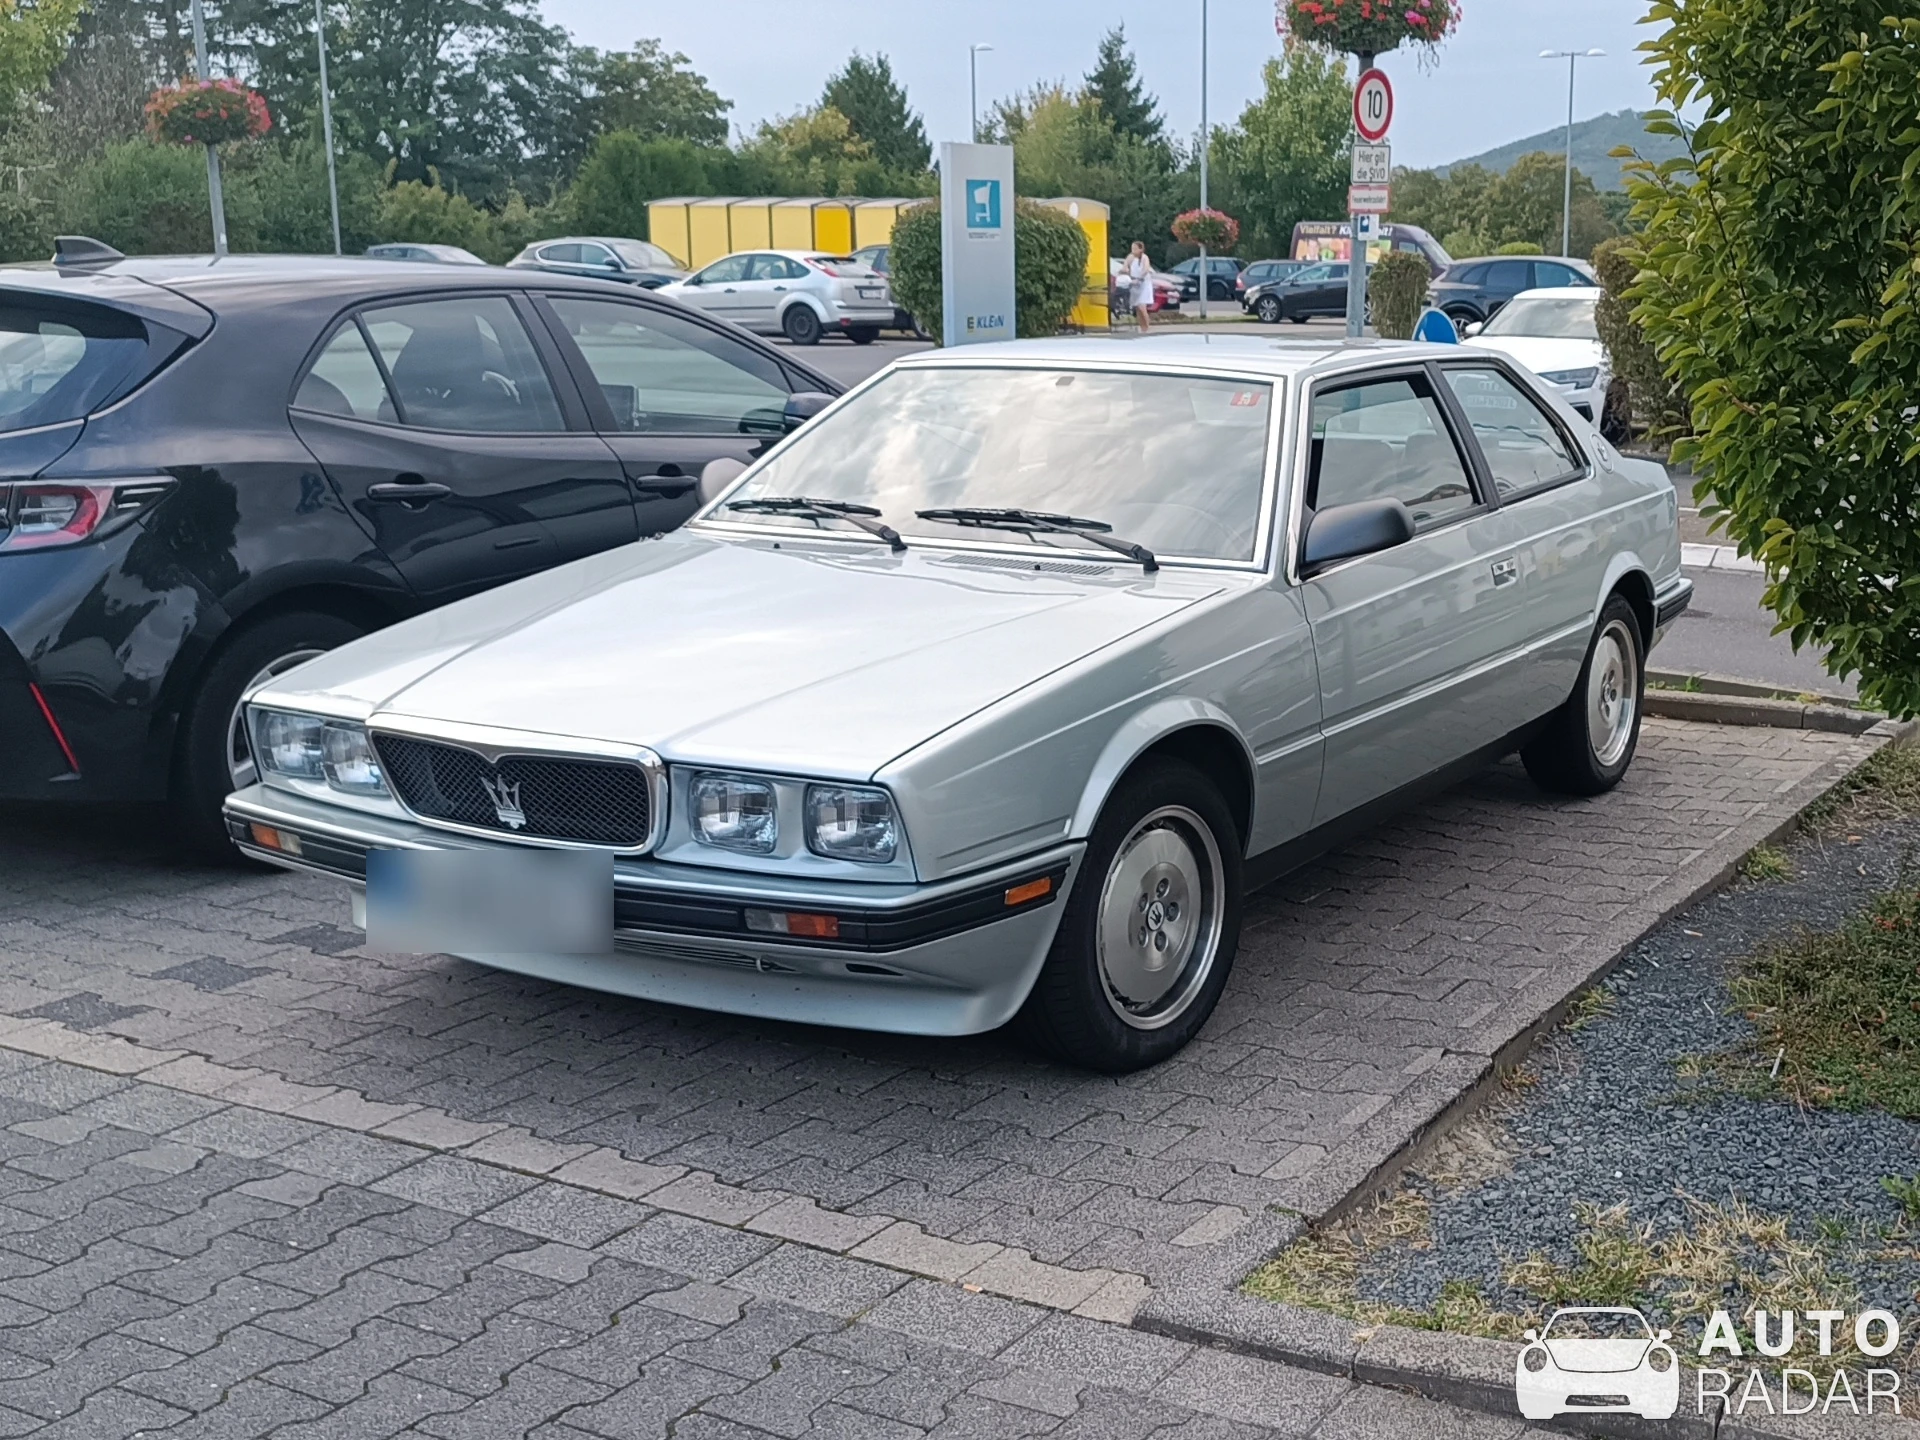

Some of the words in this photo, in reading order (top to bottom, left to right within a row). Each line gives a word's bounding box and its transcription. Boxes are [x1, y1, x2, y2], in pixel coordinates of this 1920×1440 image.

[1367, 89, 1383, 119] 10
[1358, 150, 1373, 163] Hier
[1375, 151, 1386, 167] gilt
[1356, 167, 1368, 179] die
